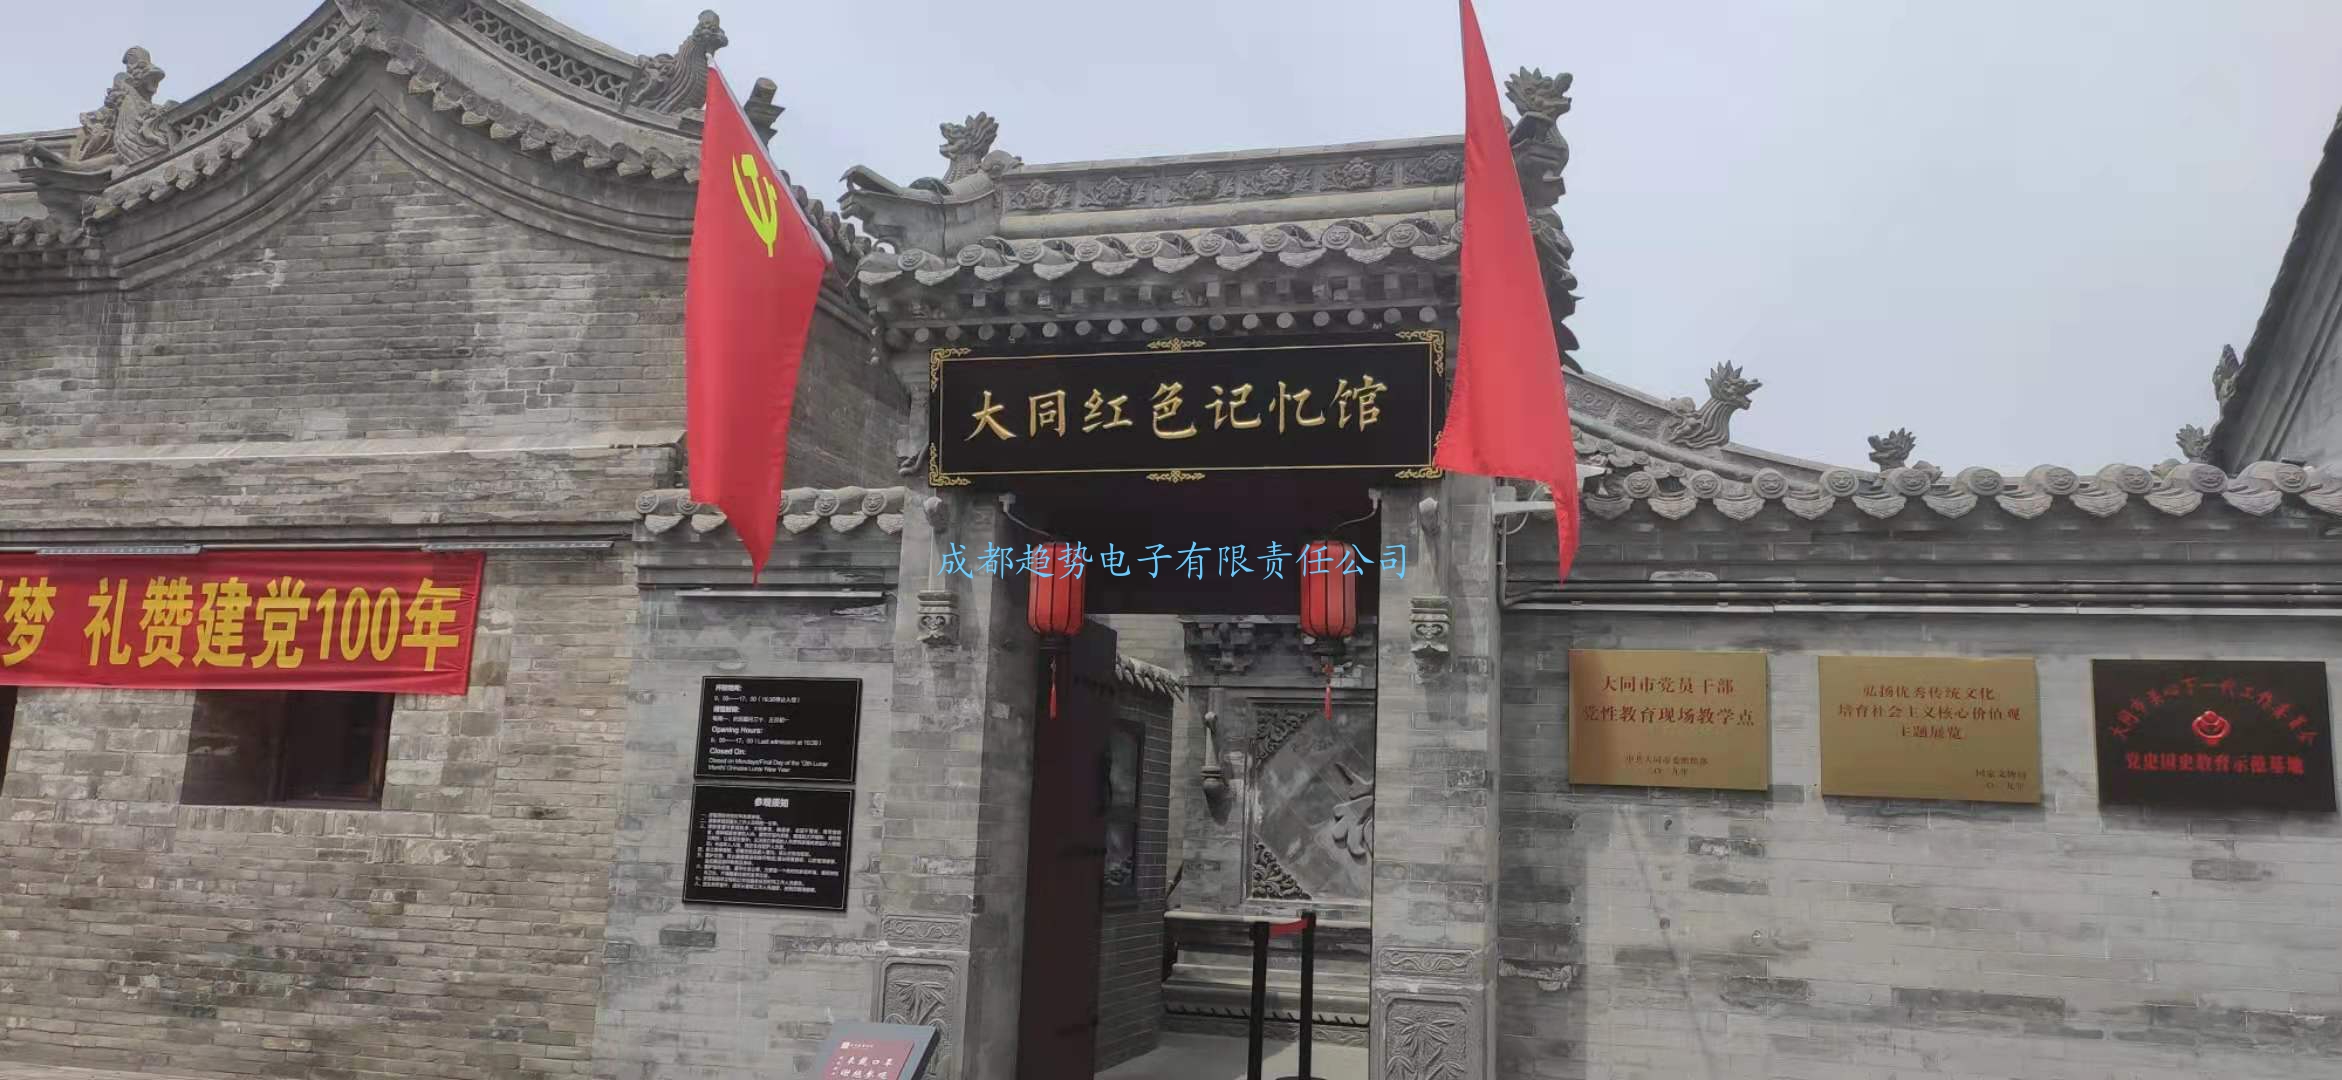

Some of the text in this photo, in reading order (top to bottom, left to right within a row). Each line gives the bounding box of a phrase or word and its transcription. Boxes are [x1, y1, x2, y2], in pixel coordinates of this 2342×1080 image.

[964, 374, 1388, 441] 大同红色记忆馆
[0, 575, 462, 672] 梦 礼赞建党100年
[1602, 675, 1734, 695] 大同市党员干部
[1863, 685, 1995, 701] 弘扬优秀传统文化
[1583, 703, 1755, 727] 党性教育现场教学点
[1839, 704, 2021, 721] 培育社会主义核心价值观
[1902, 725, 1962, 740] 主题展览
